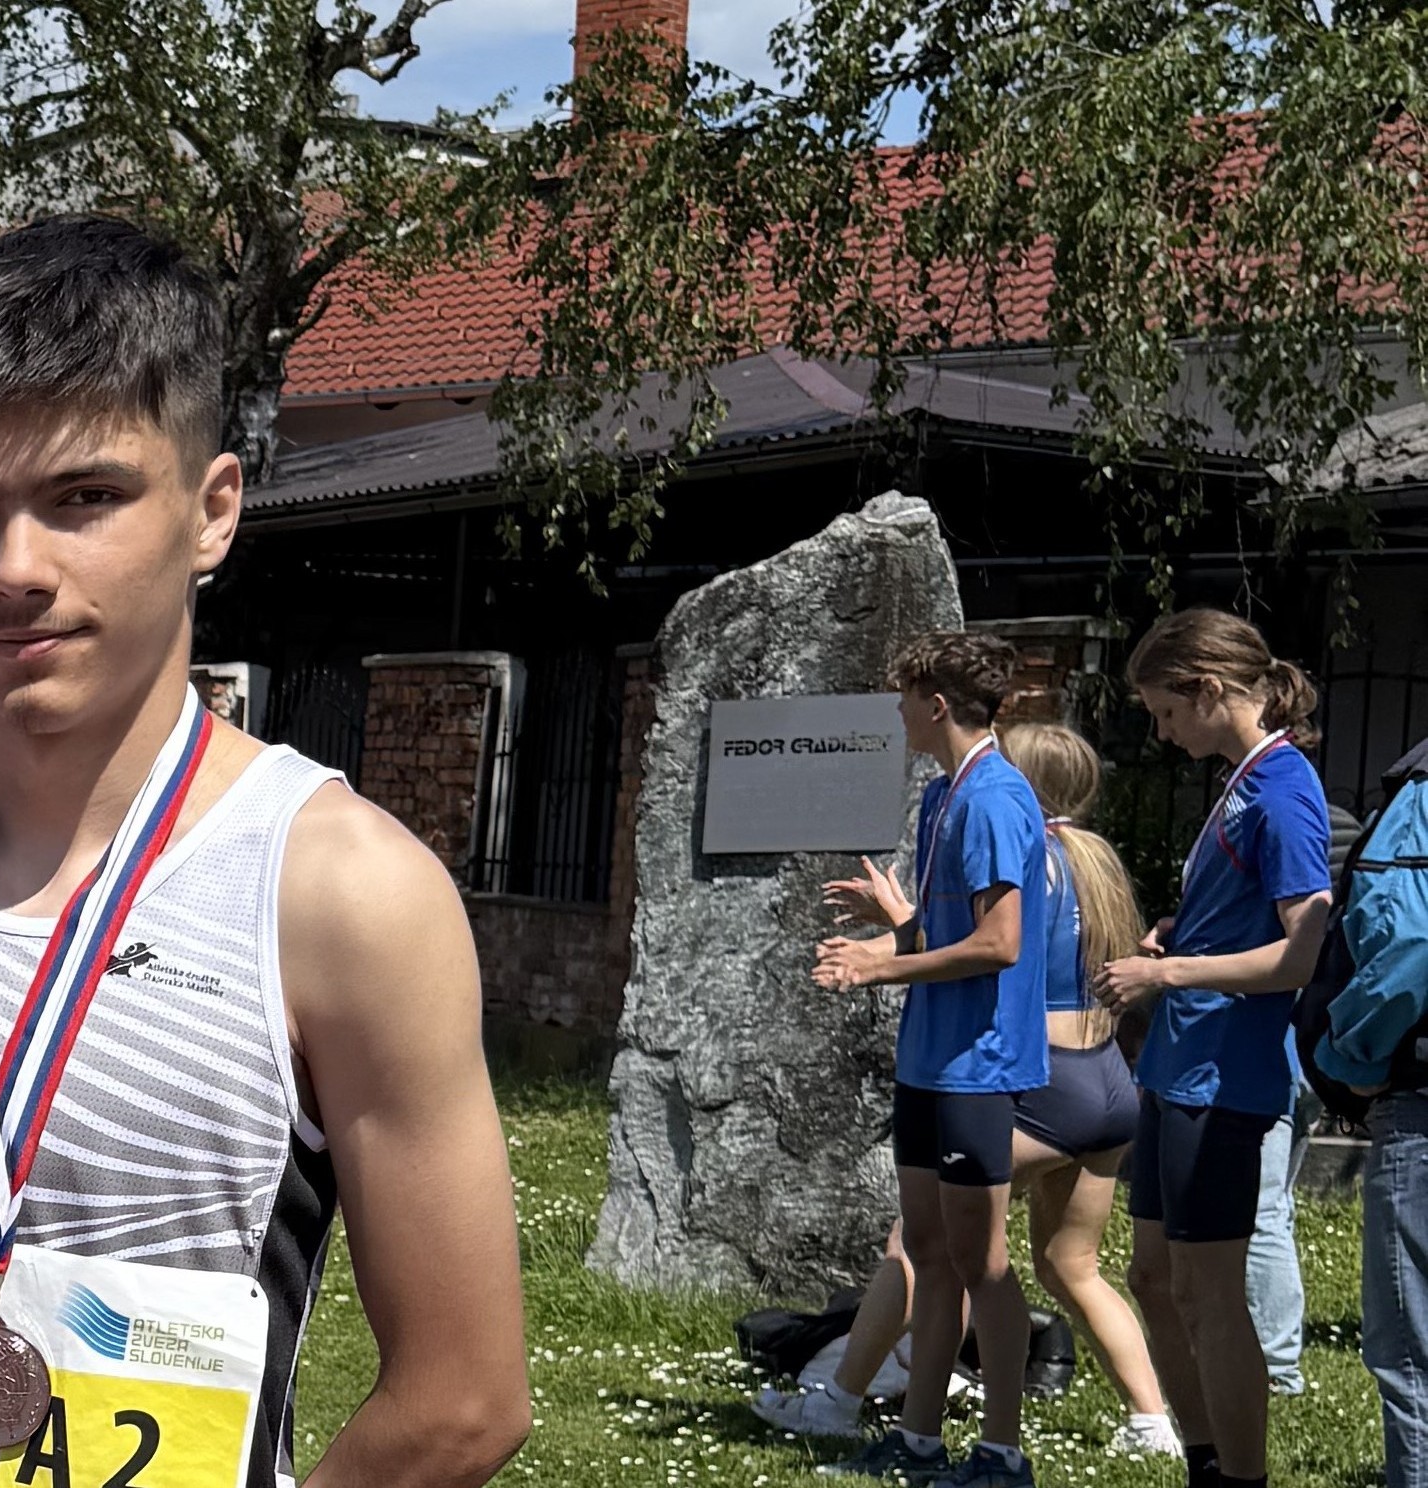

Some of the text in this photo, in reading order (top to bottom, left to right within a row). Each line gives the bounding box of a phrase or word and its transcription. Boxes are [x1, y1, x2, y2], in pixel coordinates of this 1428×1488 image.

[724, 738, 785, 757] FEDOR
[133, 1319, 225, 1342] ATLETSKA
[132, 1336, 189, 1352] ZVEZA
[129, 1352, 224, 1374] SLOVENIJE
